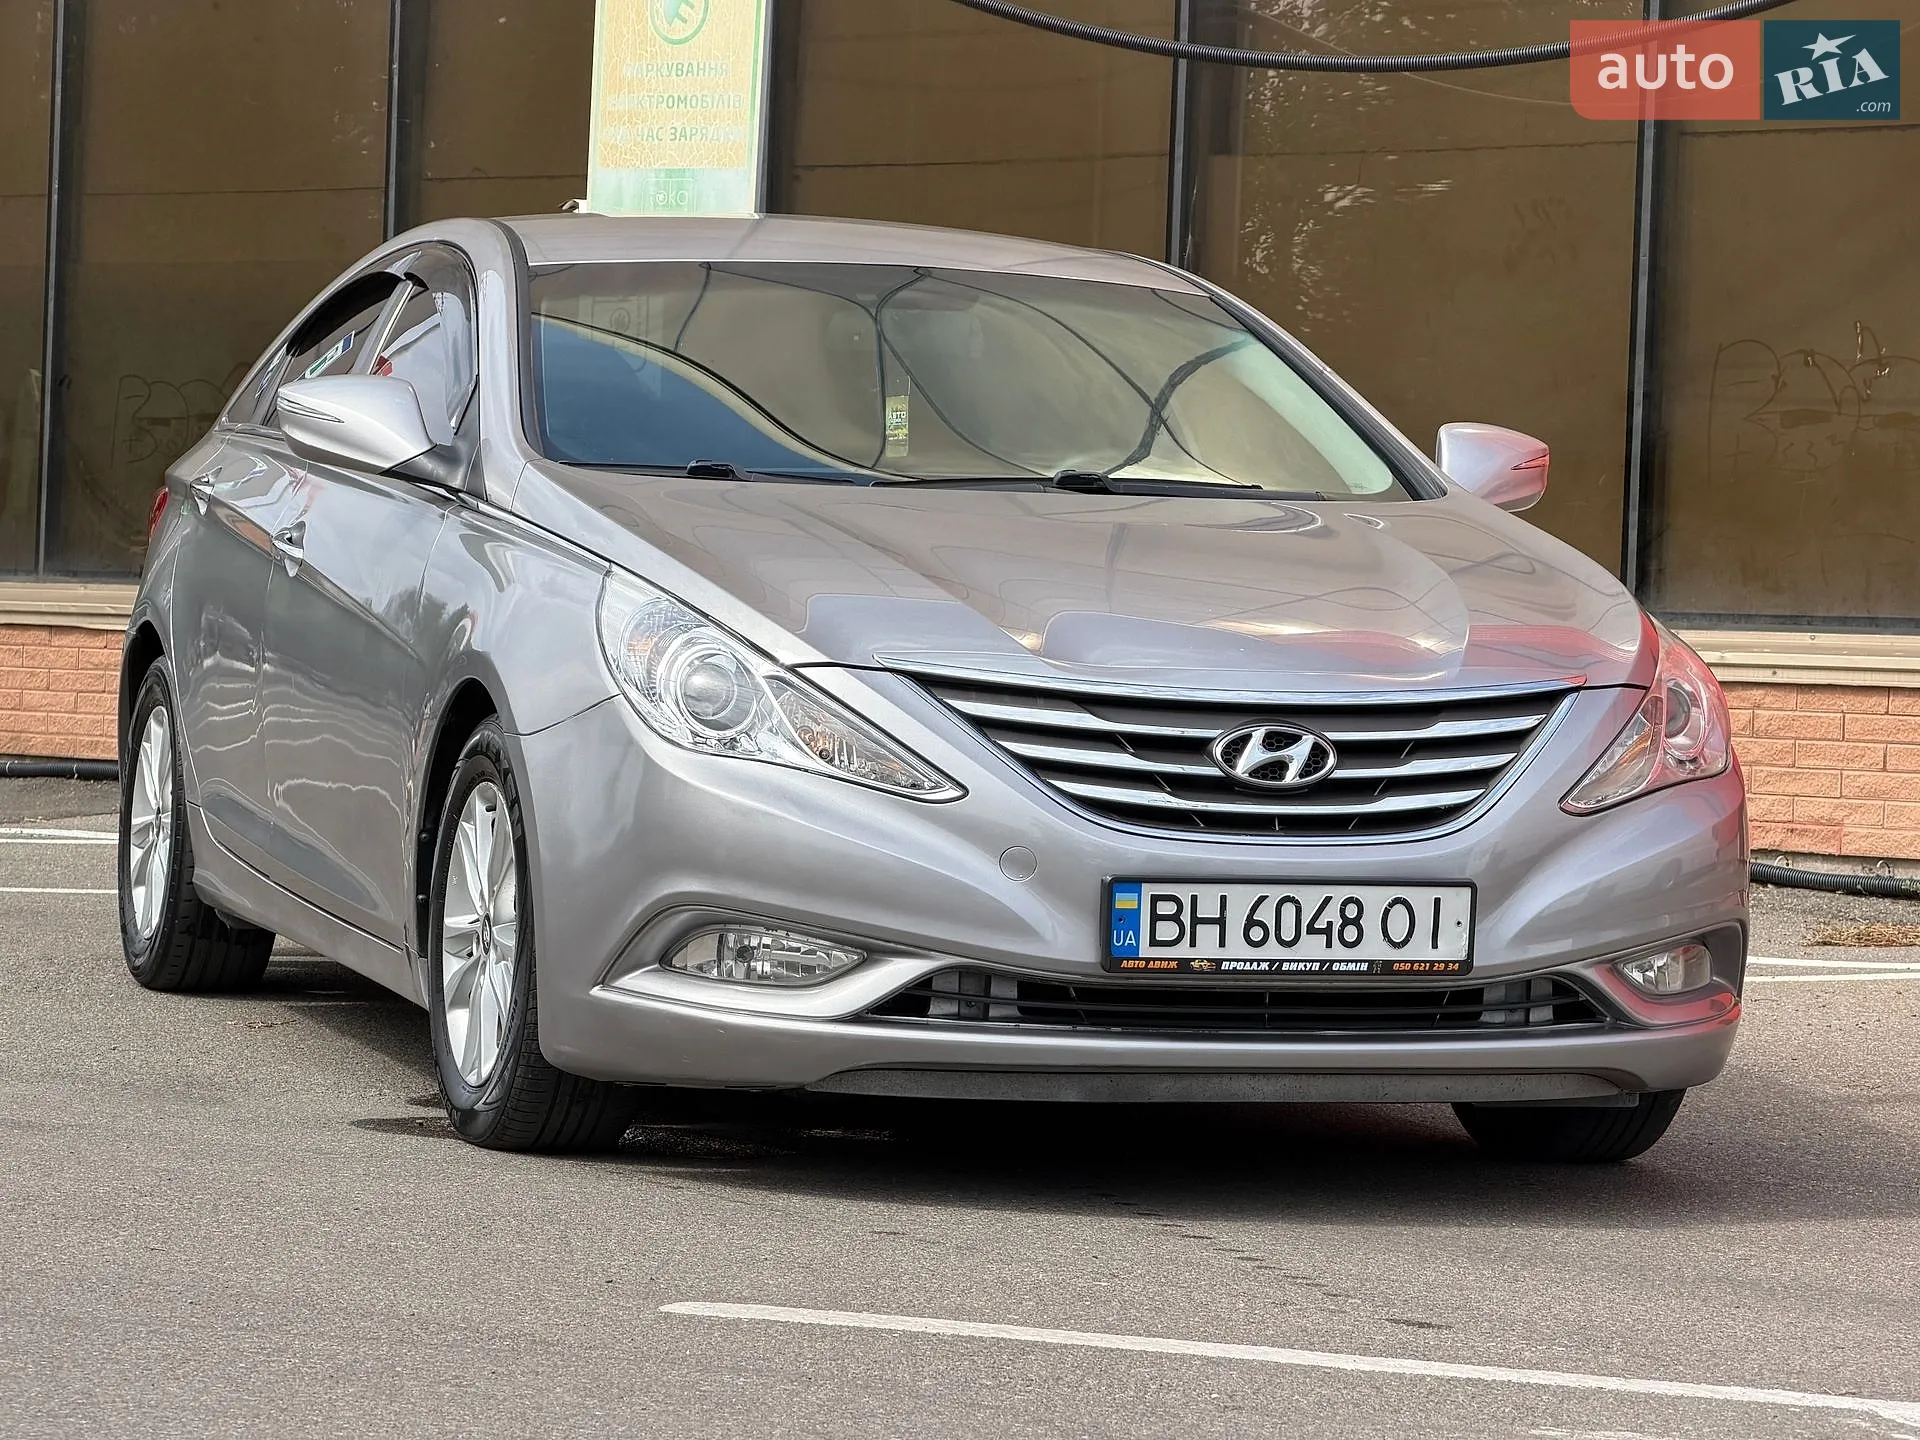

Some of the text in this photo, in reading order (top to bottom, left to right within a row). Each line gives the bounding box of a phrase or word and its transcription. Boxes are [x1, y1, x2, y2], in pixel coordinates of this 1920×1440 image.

[608, 93, 743, 110] КТРОМОБІЛІВ
[1148, 893, 1228, 948] BH
[1243, 893, 1365, 949] 6048
[1113, 930, 1137, 947] UA
[1120, 960, 1146, 969] АВТО
[1221, 961, 1270, 971] ПРОДАЖ
[1281, 962, 1319, 971] ВИКУП
[1332, 962, 1369, 971] ОБМІН
[1392, 962, 1460, 971] 050 621 29 34
